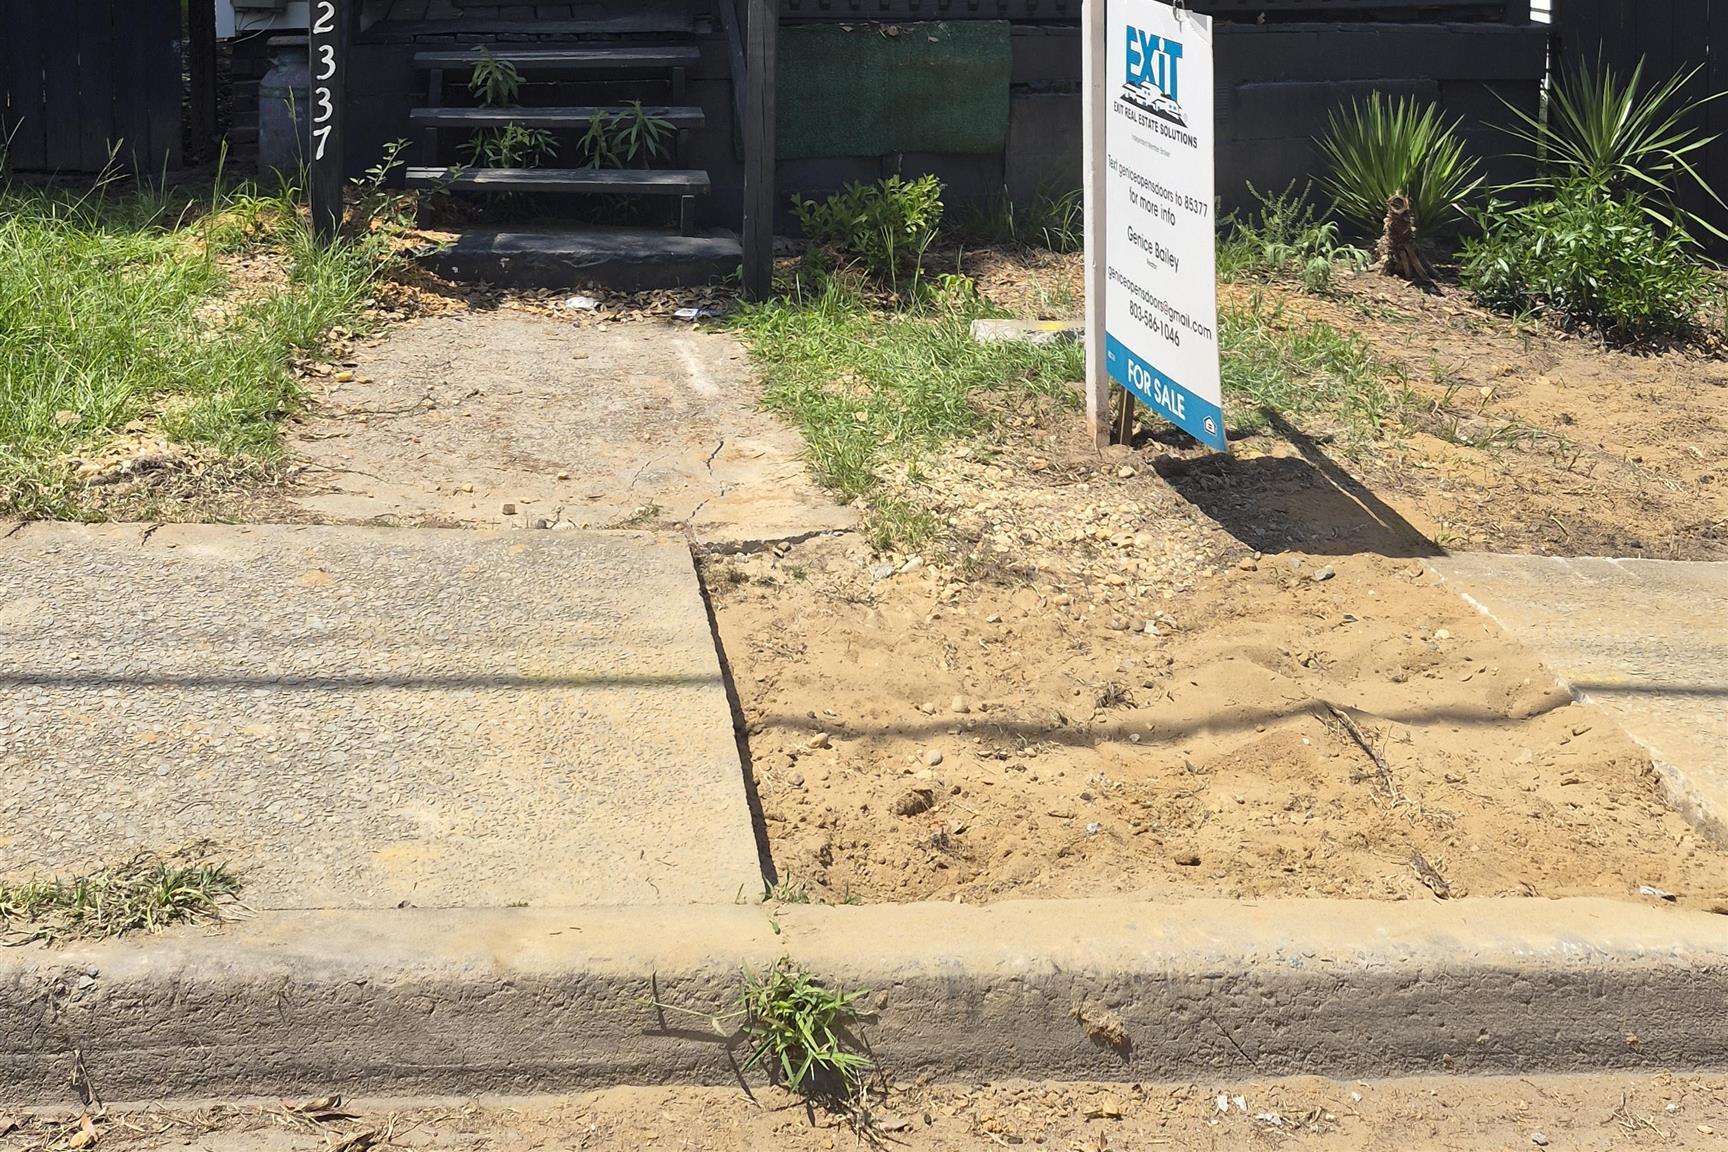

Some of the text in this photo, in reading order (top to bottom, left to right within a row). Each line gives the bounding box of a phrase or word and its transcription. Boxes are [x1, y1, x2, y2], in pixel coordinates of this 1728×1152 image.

[313, 1, 336, 160] 2337
[1113, 101, 1124, 115] EXIT
[1125, 105, 1137, 123] REAL
[1139, 114, 1158, 133] ESTATE
[1160, 123, 1198, 149] SOLUTIONS
[1108, 154, 1208, 217] Text geniceopensdoors to 85377
[1129, 187, 1176, 226] for more info
[1127, 225, 1153, 254] Genice
[1155, 242, 1179, 273] Bailey
[1108, 266, 1212, 340] geniceopensdoors@gmail.com
[1129, 299, 1180, 347] 803-586-1046
[1128, 358, 1185, 421] FOR SALE
